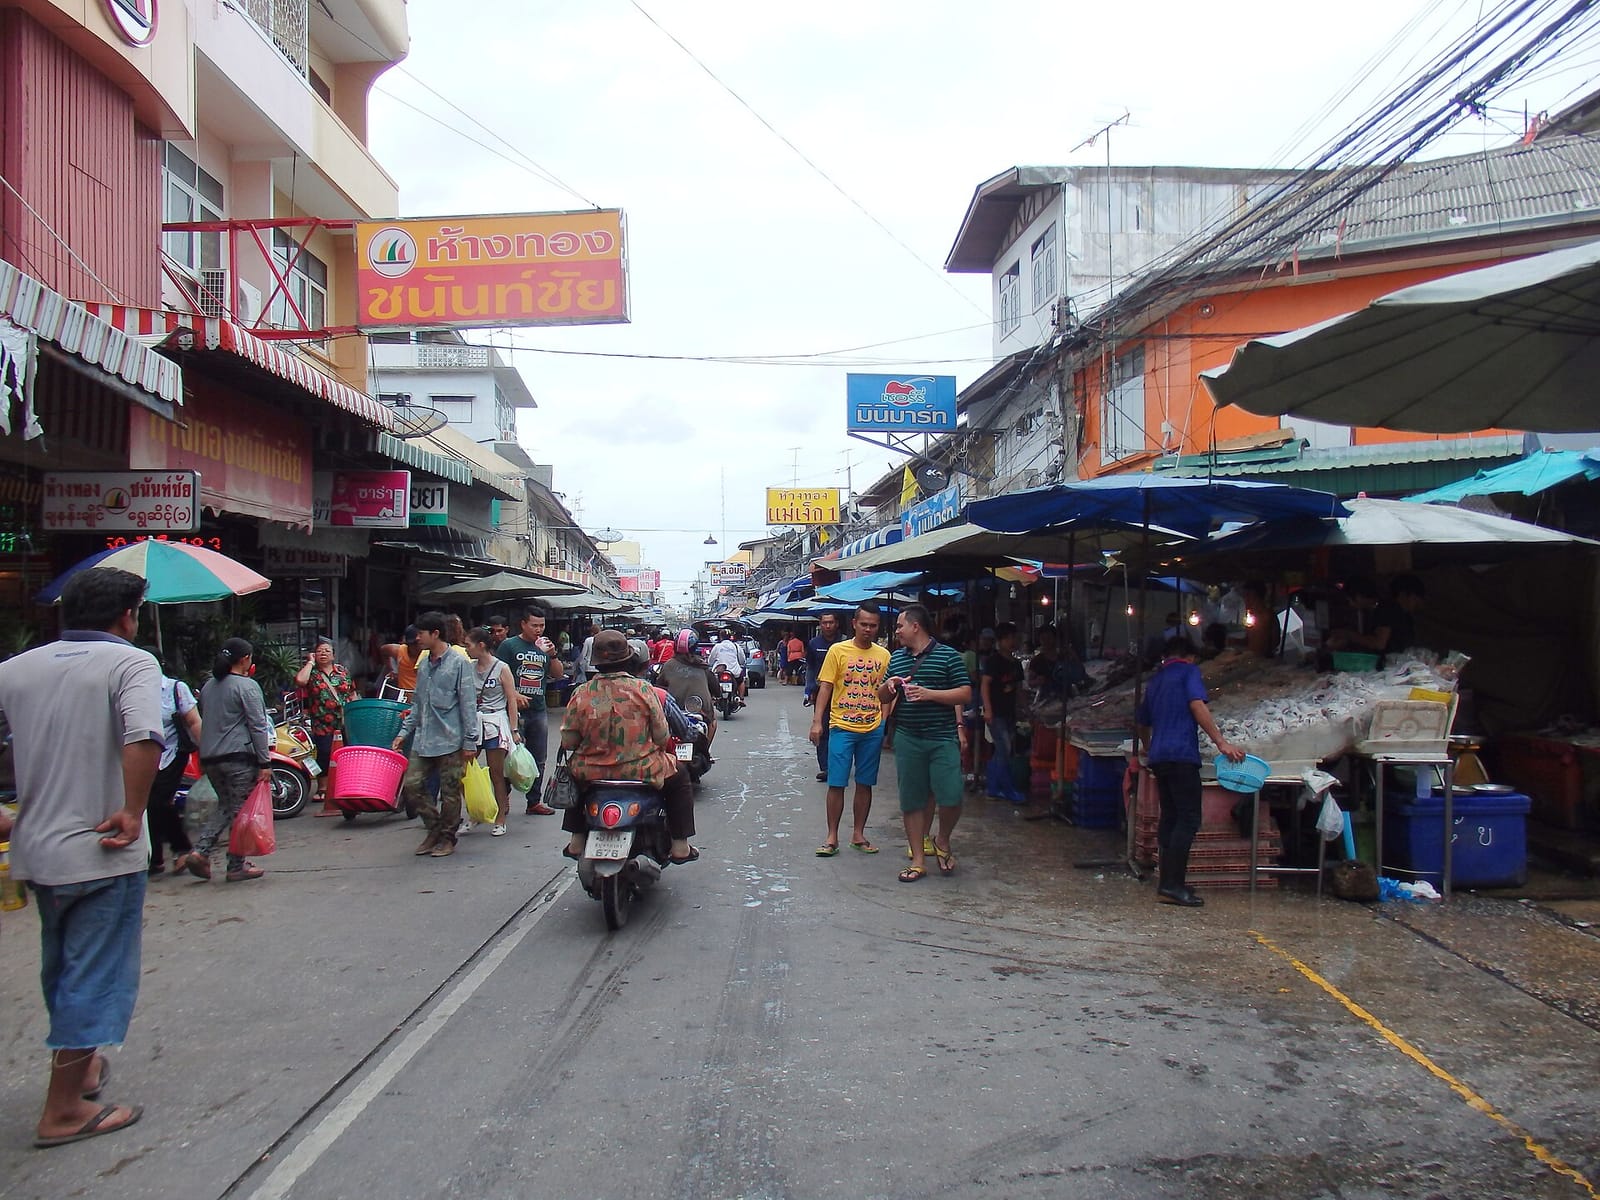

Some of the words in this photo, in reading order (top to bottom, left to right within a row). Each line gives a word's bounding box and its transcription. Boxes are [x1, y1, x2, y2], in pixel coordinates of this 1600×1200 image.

[428, 227, 615, 262] ห้างทอง
[368, 270, 616, 319] ชนันท์ชัย
[856, 403, 948, 425] มินิมาร์ท
[130, 475, 191, 498] ชนันท์ชัย
[779, 490, 828, 501] ห้างทอง
[828, 506, 837, 521] 1
